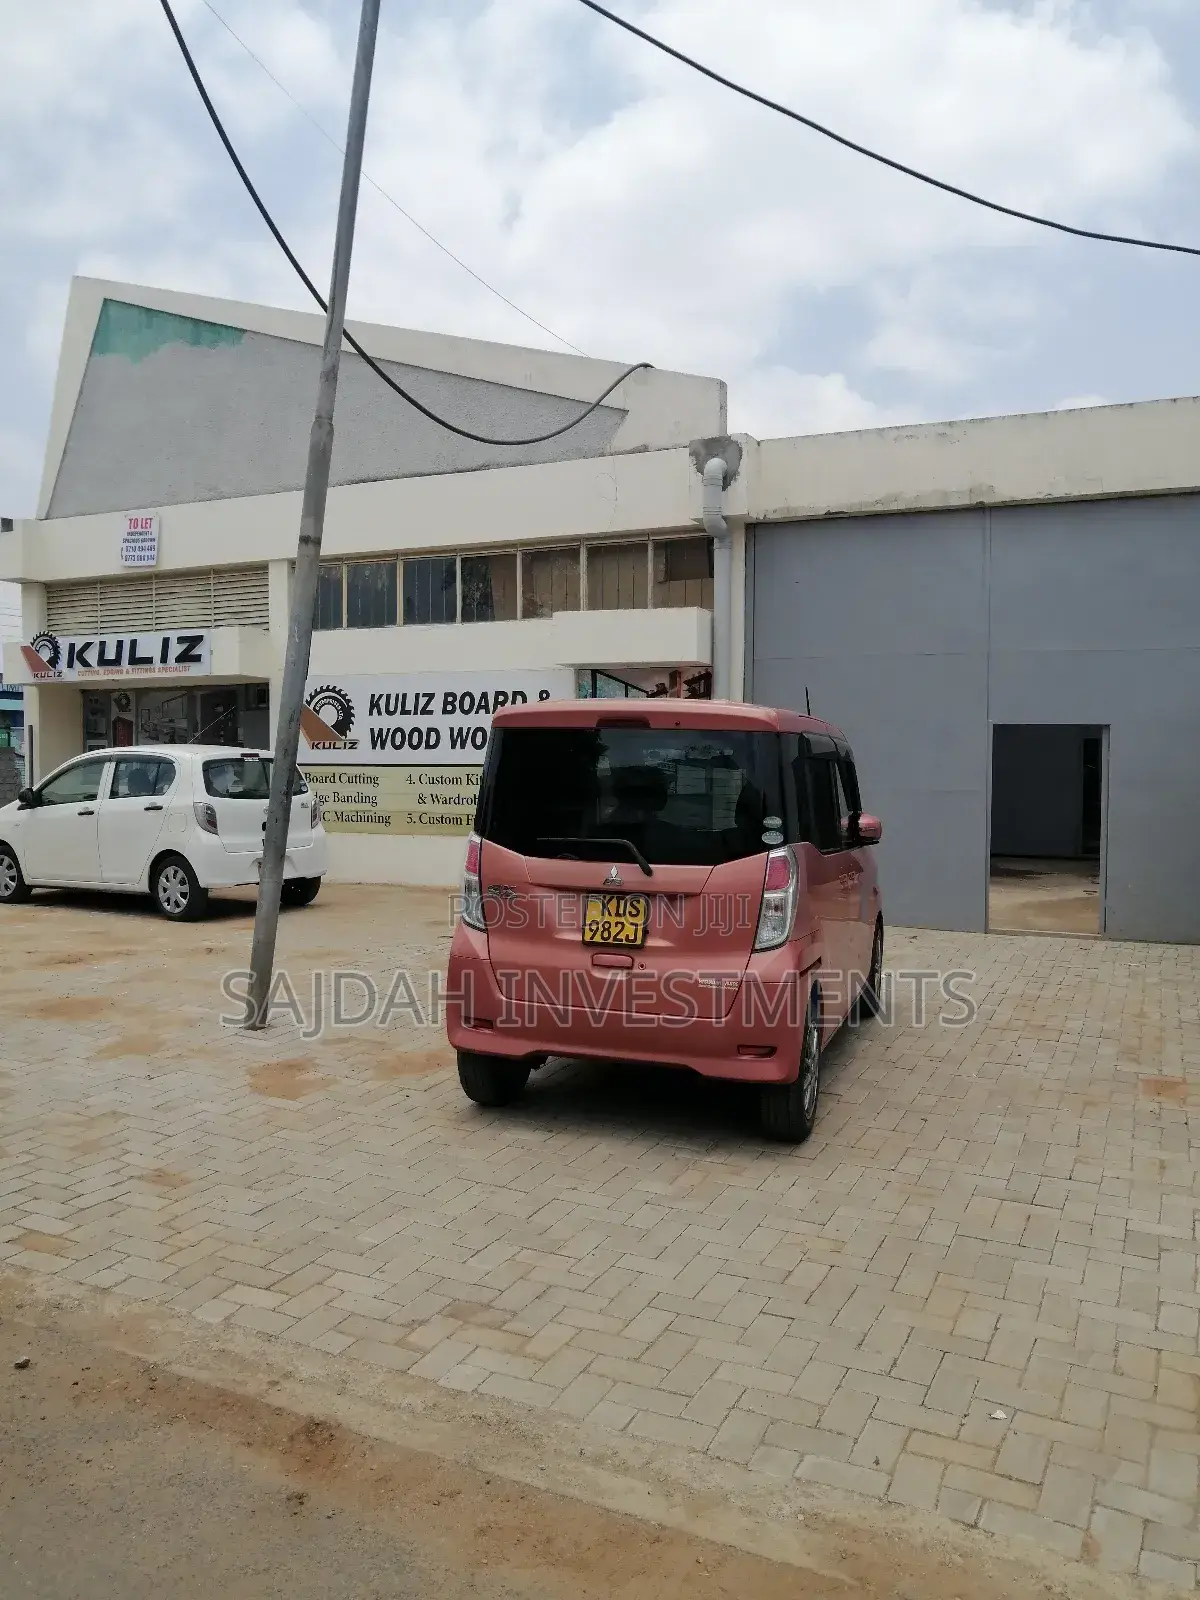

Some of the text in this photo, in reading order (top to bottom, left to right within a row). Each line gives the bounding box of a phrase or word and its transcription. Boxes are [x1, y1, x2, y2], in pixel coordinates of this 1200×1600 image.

[128, 517, 153, 530] TO LET
[66, 634, 204, 668] KULIZ
[33, 671, 63, 679] KULIZ
[157, 665, 192, 673] SPECIALIST
[368, 692, 436, 717] KULIZ
[441, 689, 528, 715] BOARD
[311, 741, 359, 750] KULIZ
[369, 726, 488, 751] WOOD WO
[304, 772, 380, 789] Board Cutting
[405, 773, 483, 786] 4. Custom Ki
[313, 791, 378, 808] dge Banding
[417, 792, 480, 806] & Wardrob
[334, 810, 391, 828] Machining
[406, 812, 417, 825] 5.
[418, 812, 463, 826] Custom
[601, 894, 641, 918] KDS
[587, 919, 639, 944] 982J
